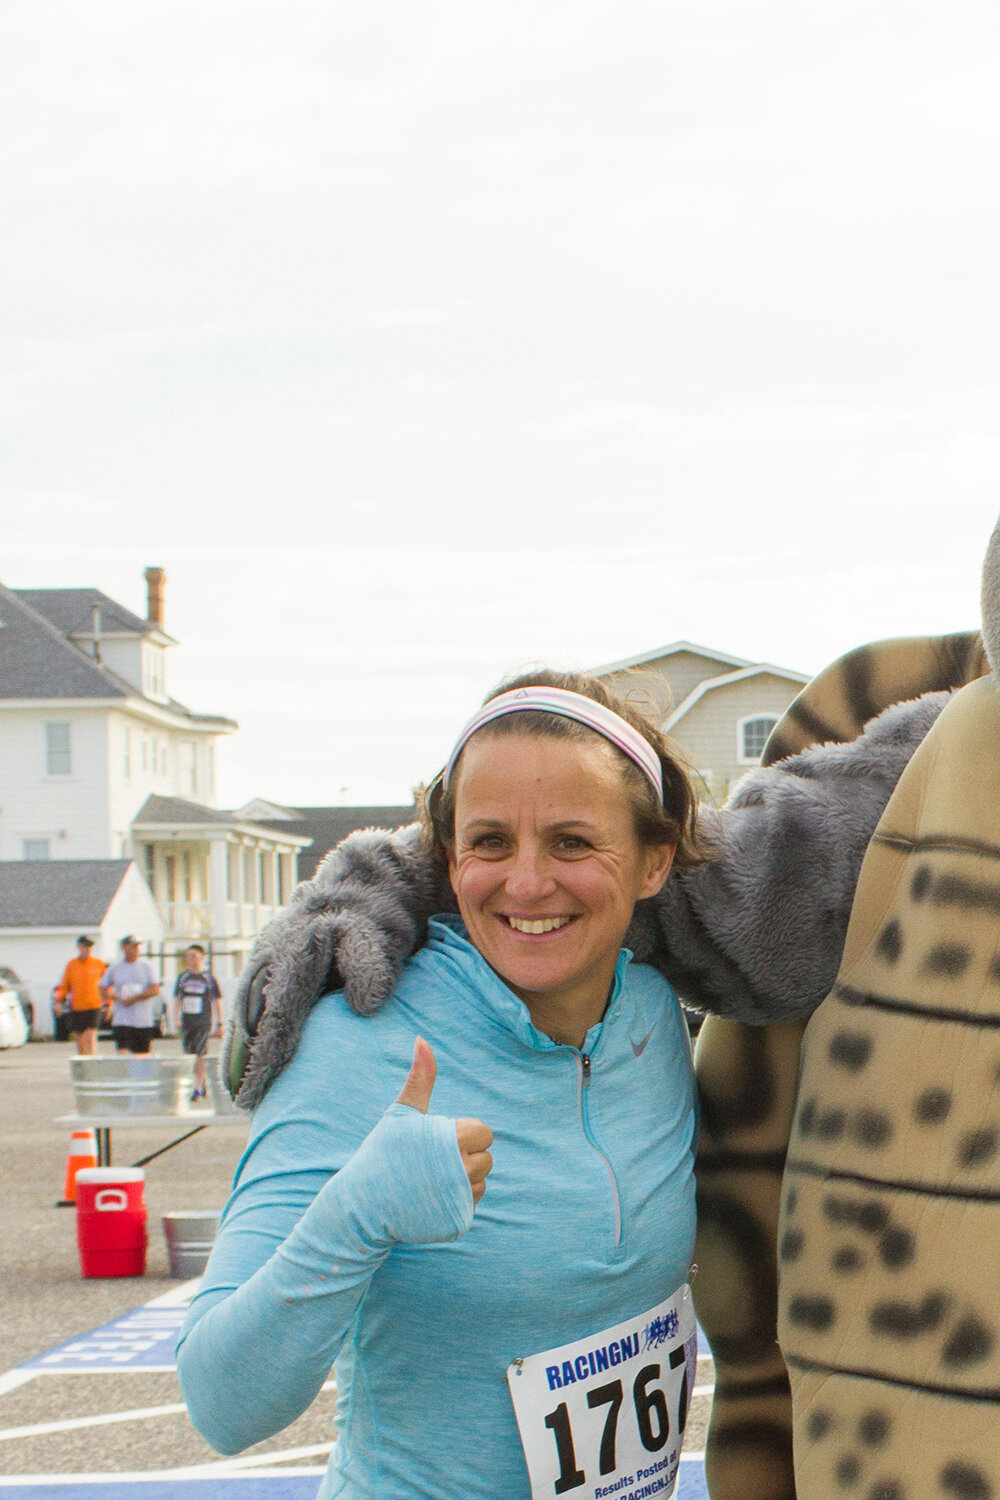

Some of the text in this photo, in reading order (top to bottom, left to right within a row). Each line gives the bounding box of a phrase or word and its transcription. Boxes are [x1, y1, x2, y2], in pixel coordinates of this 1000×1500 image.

[545, 1332, 640, 1391] RACINGNJ
[544, 1344, 687, 1495] 1767
[594, 1475, 634, 1499] Results
[636, 1456, 668, 1481] Posted
